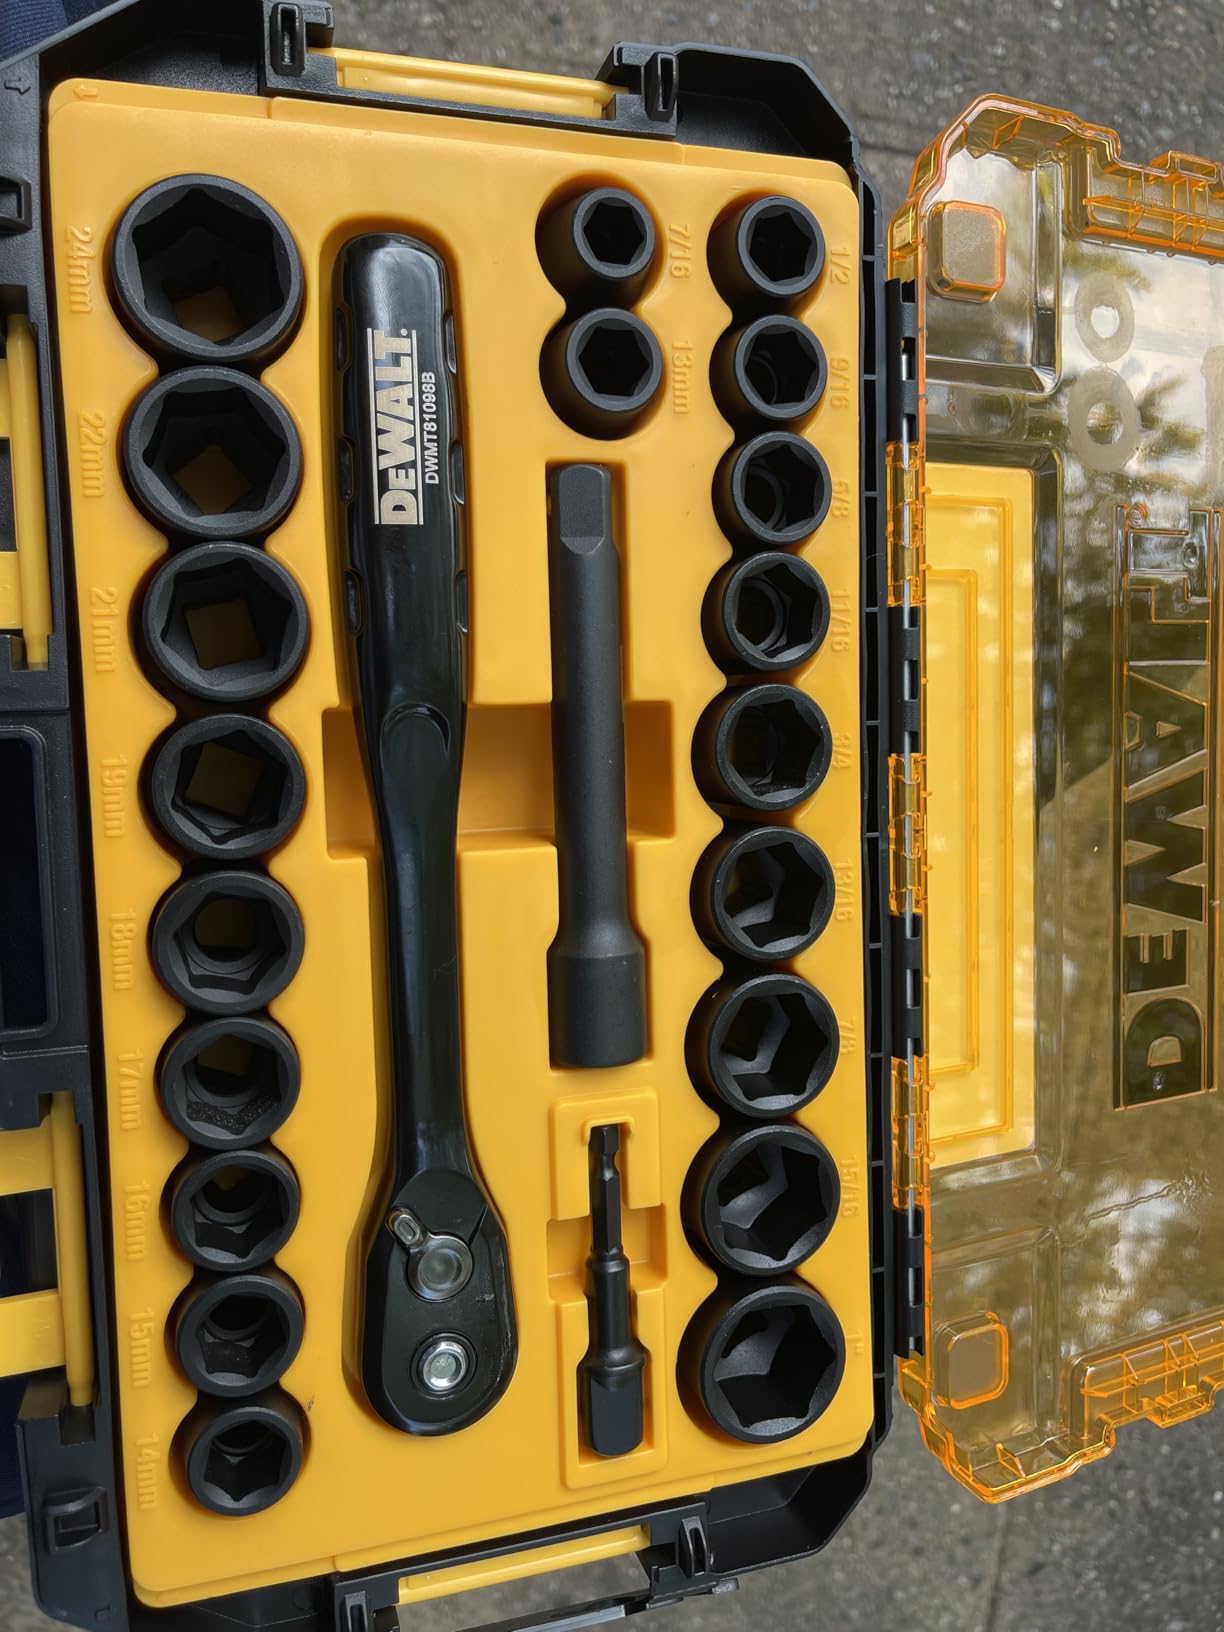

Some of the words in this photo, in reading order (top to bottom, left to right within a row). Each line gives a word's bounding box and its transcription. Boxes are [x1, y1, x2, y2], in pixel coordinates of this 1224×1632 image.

[64, 224, 96, 316] 24mm
[669, 222, 693, 281] 7/16
[829, 247, 851, 286] 1/2
[671, 338, 694, 416] 13mm
[829, 358, 850, 410] 9/16
[77, 410, 106, 499] 22mm
[421, 371, 440, 485] DWMT81098B
[830, 480, 852, 520] 5/8
[90, 586, 119, 674] 21mm
[830, 586, 852, 652] 11/16
[832, 732, 852, 770] 3/4
[100, 754, 129, 839] 19mm
[834, 858, 855, 923] 13/16
[110, 906, 137, 993] 18mm
[839, 1018, 857, 1056] 7/8
[116, 1048, 144, 1132] 17mm
[124, 1180, 150, 1263] 16mm
[840, 1154, 861, 1218] 15/16
[129, 1307, 155, 1389] 15mm
[135, 1431, 161, 1513] 14mm
